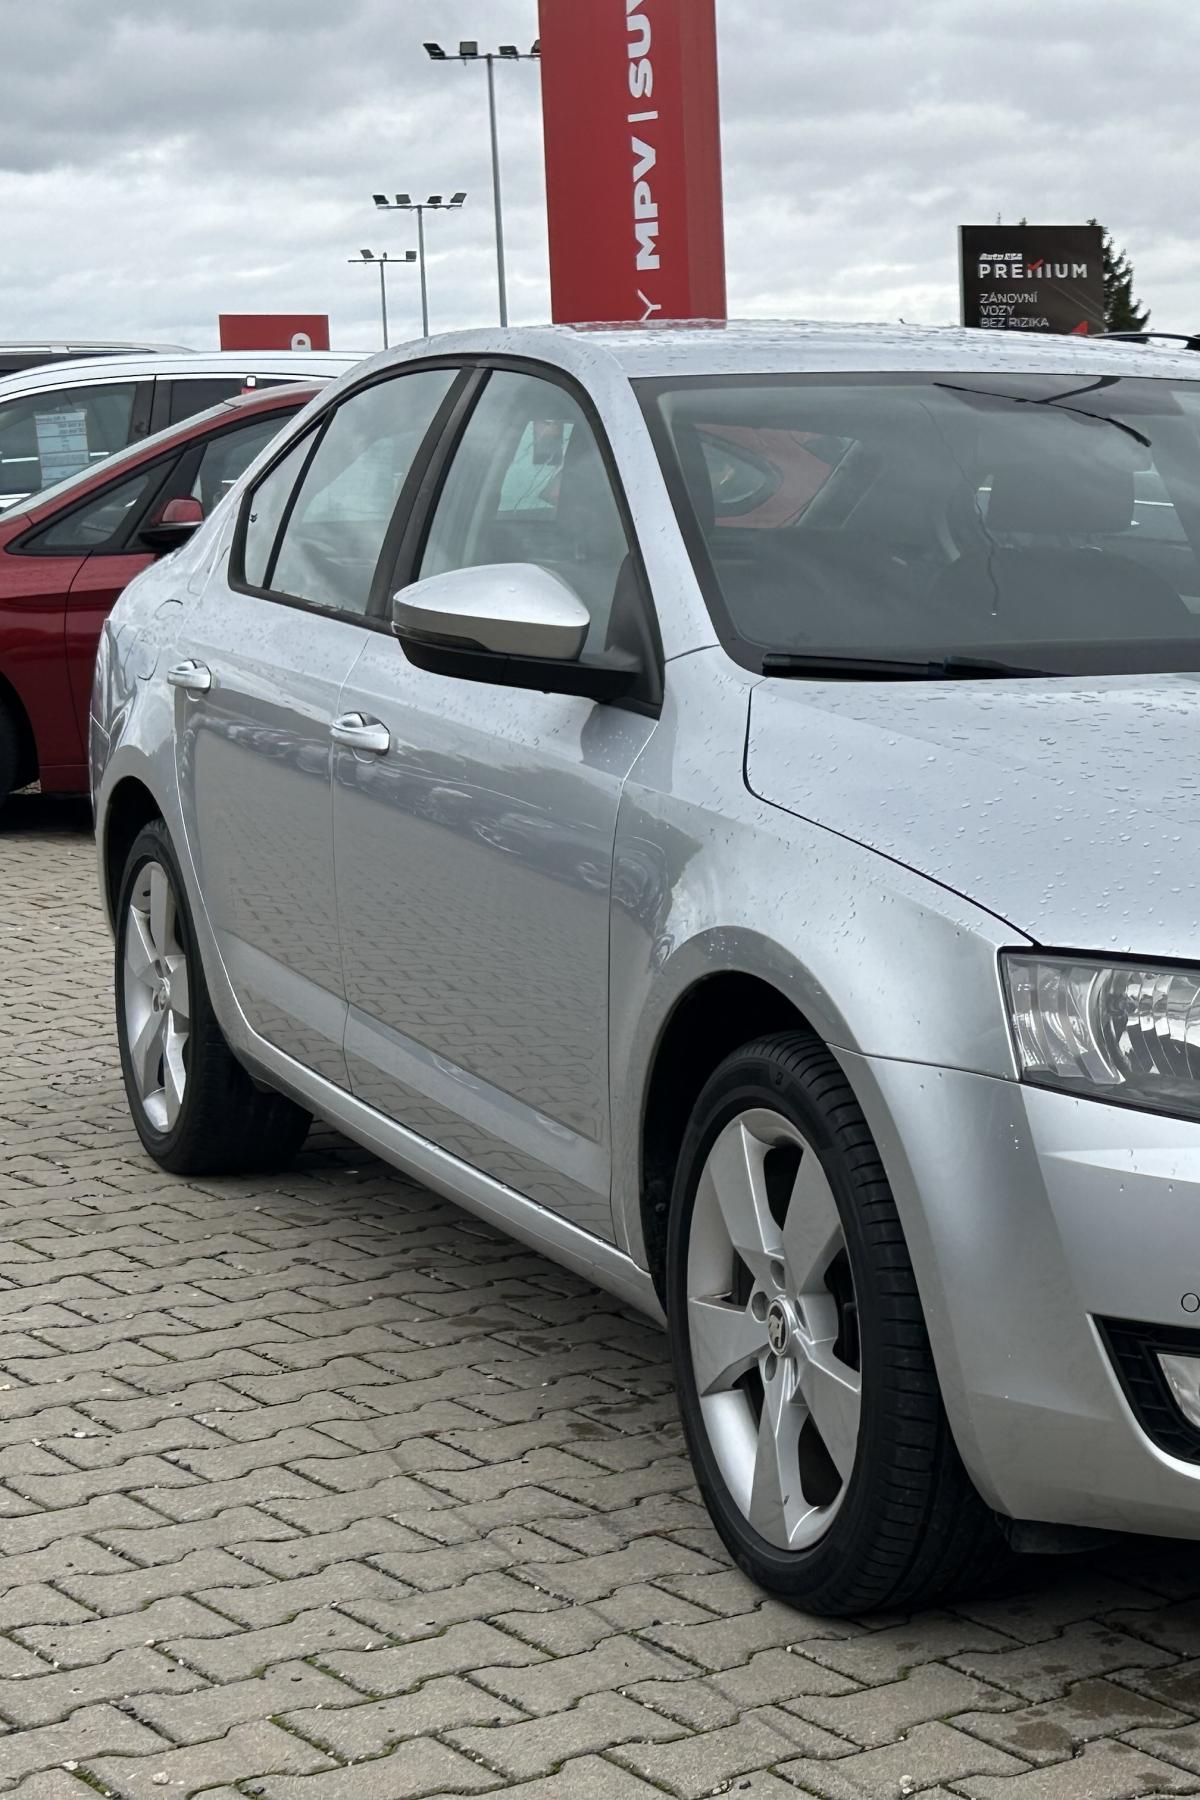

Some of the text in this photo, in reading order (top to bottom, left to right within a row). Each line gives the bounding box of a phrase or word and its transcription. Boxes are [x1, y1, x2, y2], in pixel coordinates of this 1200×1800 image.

[631, 136, 660, 271] MPV
[979, 262, 1088, 278] PREMIUM
[980, 291, 1038, 304] ZÁNOVNÍ
[980, 305, 1015, 316] VOZY
[981, 317, 1050, 328] BEZ RIZIKA
